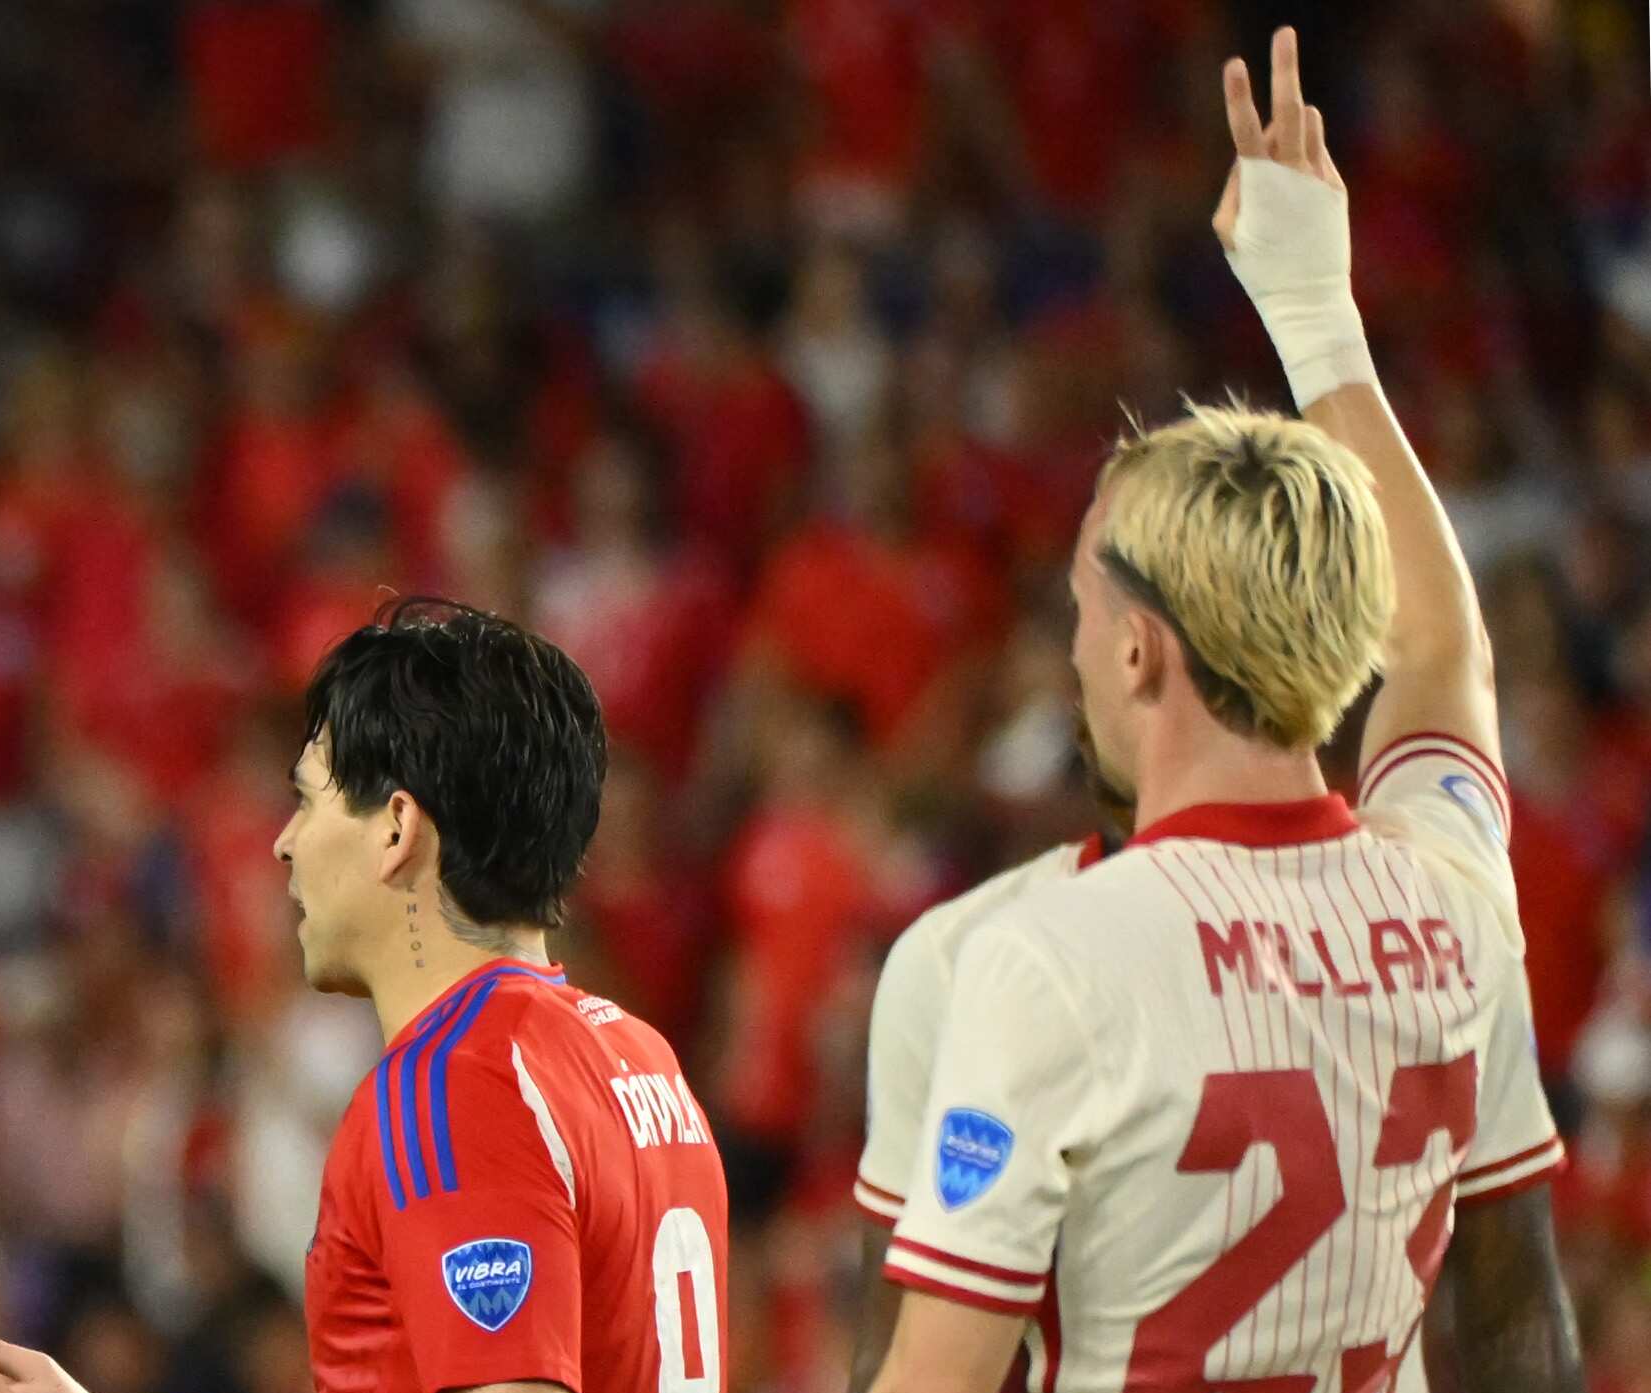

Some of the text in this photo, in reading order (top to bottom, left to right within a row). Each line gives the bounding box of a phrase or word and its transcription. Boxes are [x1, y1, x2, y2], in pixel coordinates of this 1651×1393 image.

[1196, 919, 1475, 998] MILLAR
[610, 1058, 709, 1149] DÁVILA
[455, 1260, 521, 1283] VIBRA
